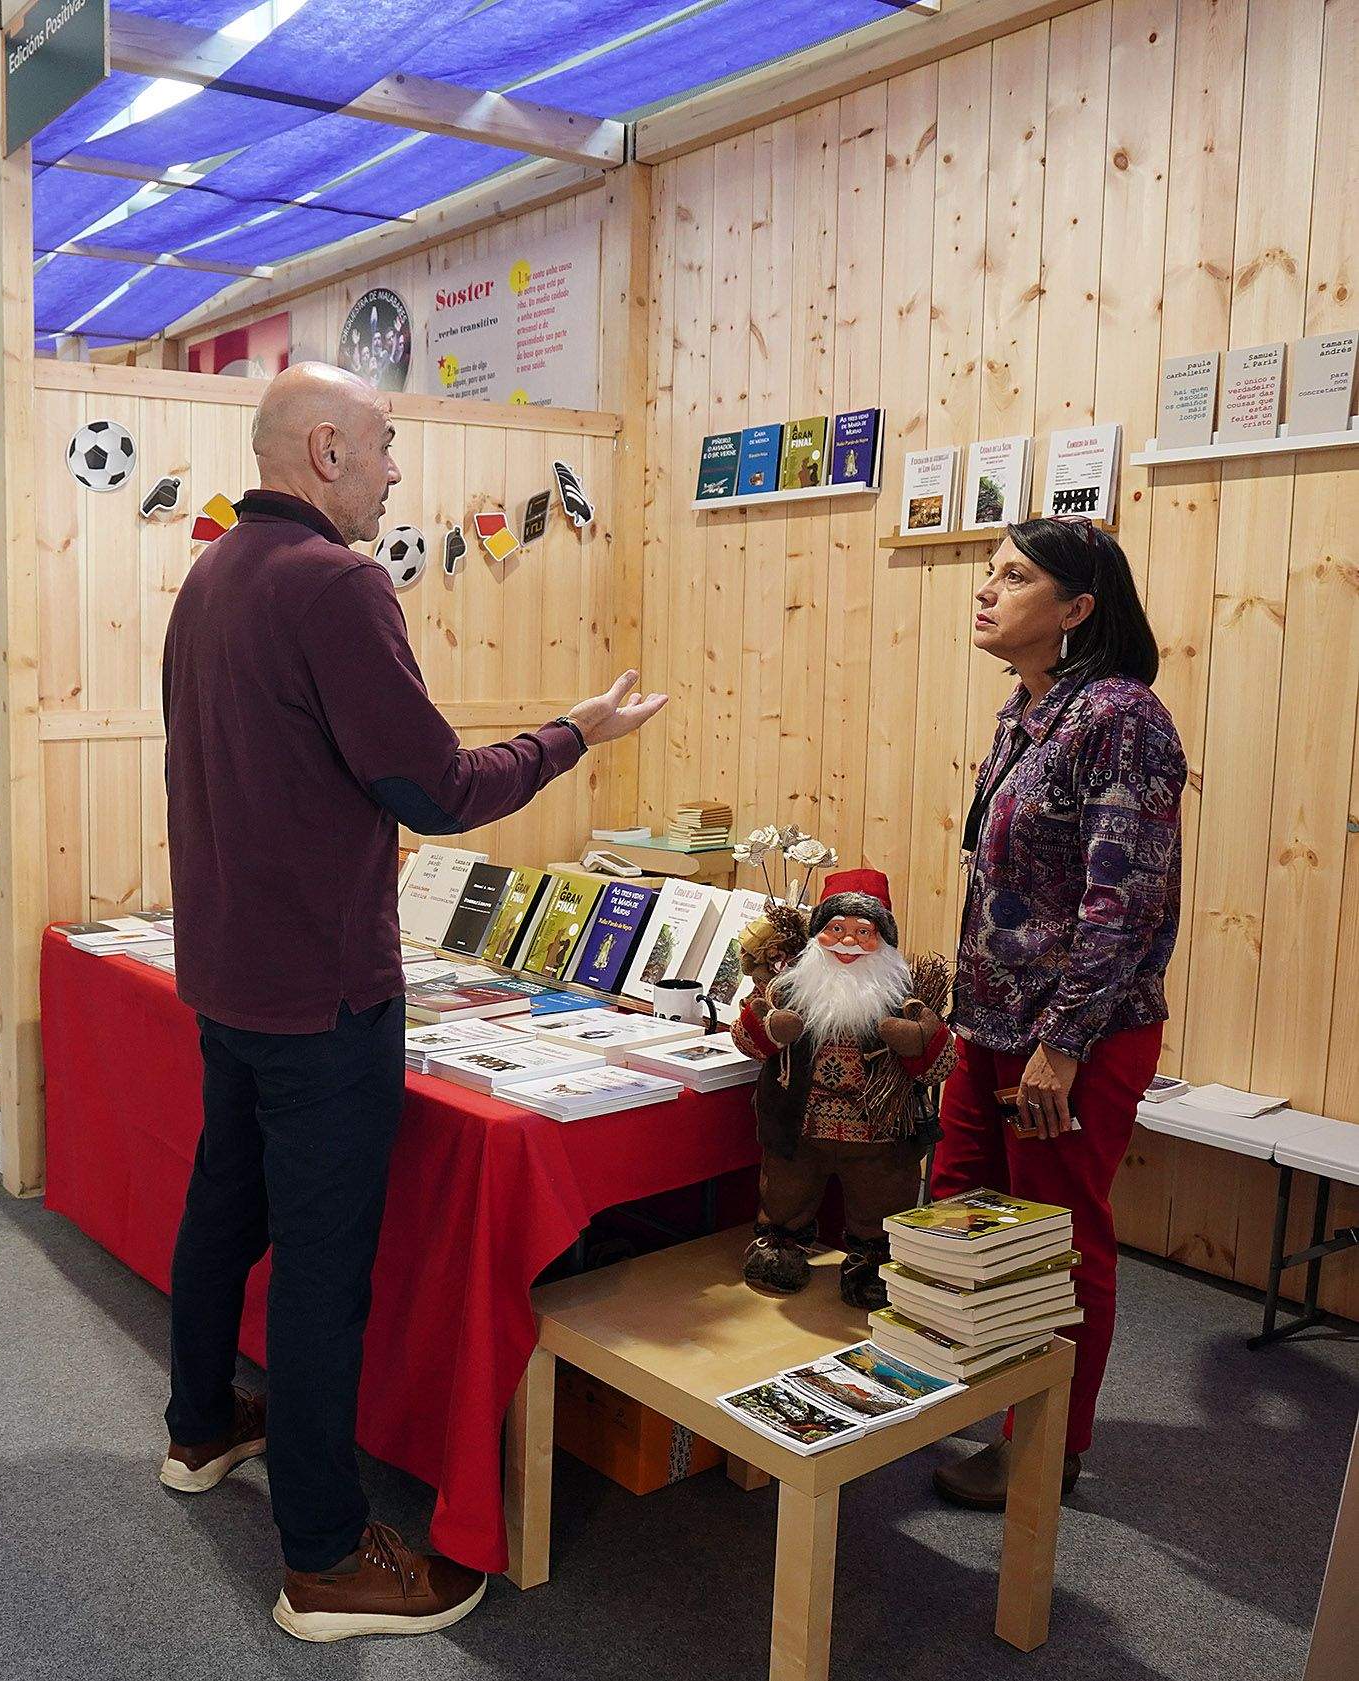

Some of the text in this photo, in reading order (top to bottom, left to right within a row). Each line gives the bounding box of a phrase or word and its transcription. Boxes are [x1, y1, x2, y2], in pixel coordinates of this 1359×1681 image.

[8, 30, 45, 74] Edicións
[435, 280, 494, 312] Soster
[460, 316, 499, 334] transitivo
[1321, 339, 1353, 349] tamara
[1248, 350, 1278, 361] Samuel
[1320, 346, 1353, 357] andrés
[1187, 360, 1212, 371] paula
[1166, 368, 1211, 380] carballeira
[1330, 372, 1349, 381] para
[1190, 386, 1209, 395] quen
[1228, 383, 1276, 395] verdadeiro
[1298, 386, 1348, 397] concretarme
[1179, 393, 1208, 401] escolle
[1236, 393, 1256, 401] deus
[1227, 401, 1256, 410] cousas
[1179, 413, 1207, 421] longos
[1231, 414, 1258, 423] feitas
[1242, 419, 1272, 429] cristo
[792, 430, 813, 440] GRAN
[791, 438, 813, 449] FINAL
[562, 881, 570, 891] A
[612, 886, 620, 896] AS
[559, 891, 583, 904] GRAN
[555, 901, 578, 915] FINAL
